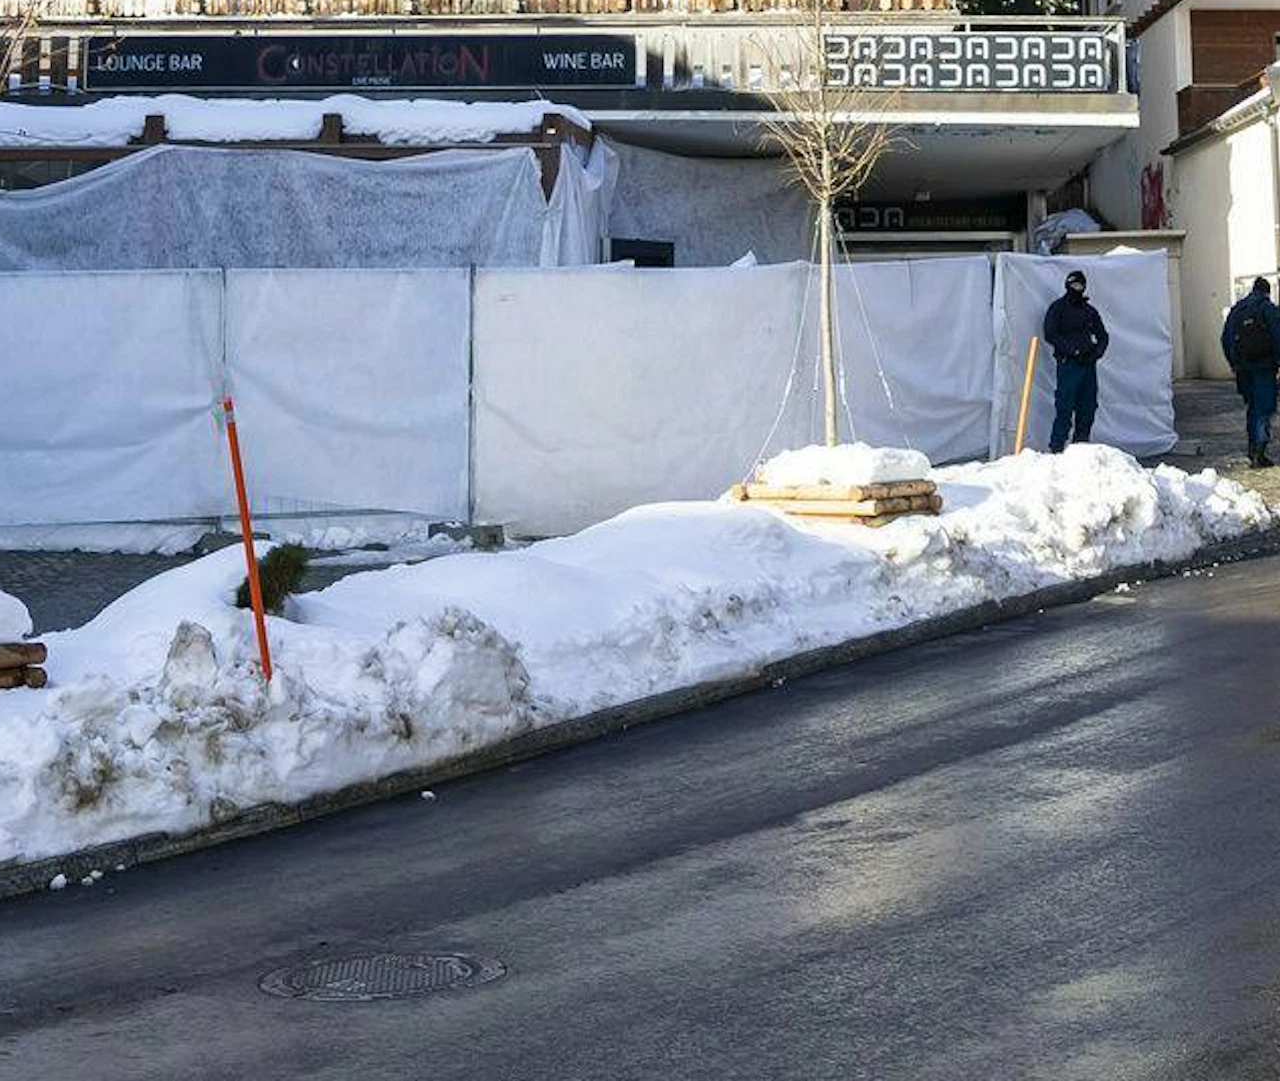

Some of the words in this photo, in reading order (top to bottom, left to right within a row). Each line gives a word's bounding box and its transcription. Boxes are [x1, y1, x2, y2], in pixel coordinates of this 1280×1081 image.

[97, 54, 165, 71] LOUNGE
[169, 53, 202, 71] BAR
[543, 52, 587, 70] WINE
[590, 52, 625, 70] BAR
